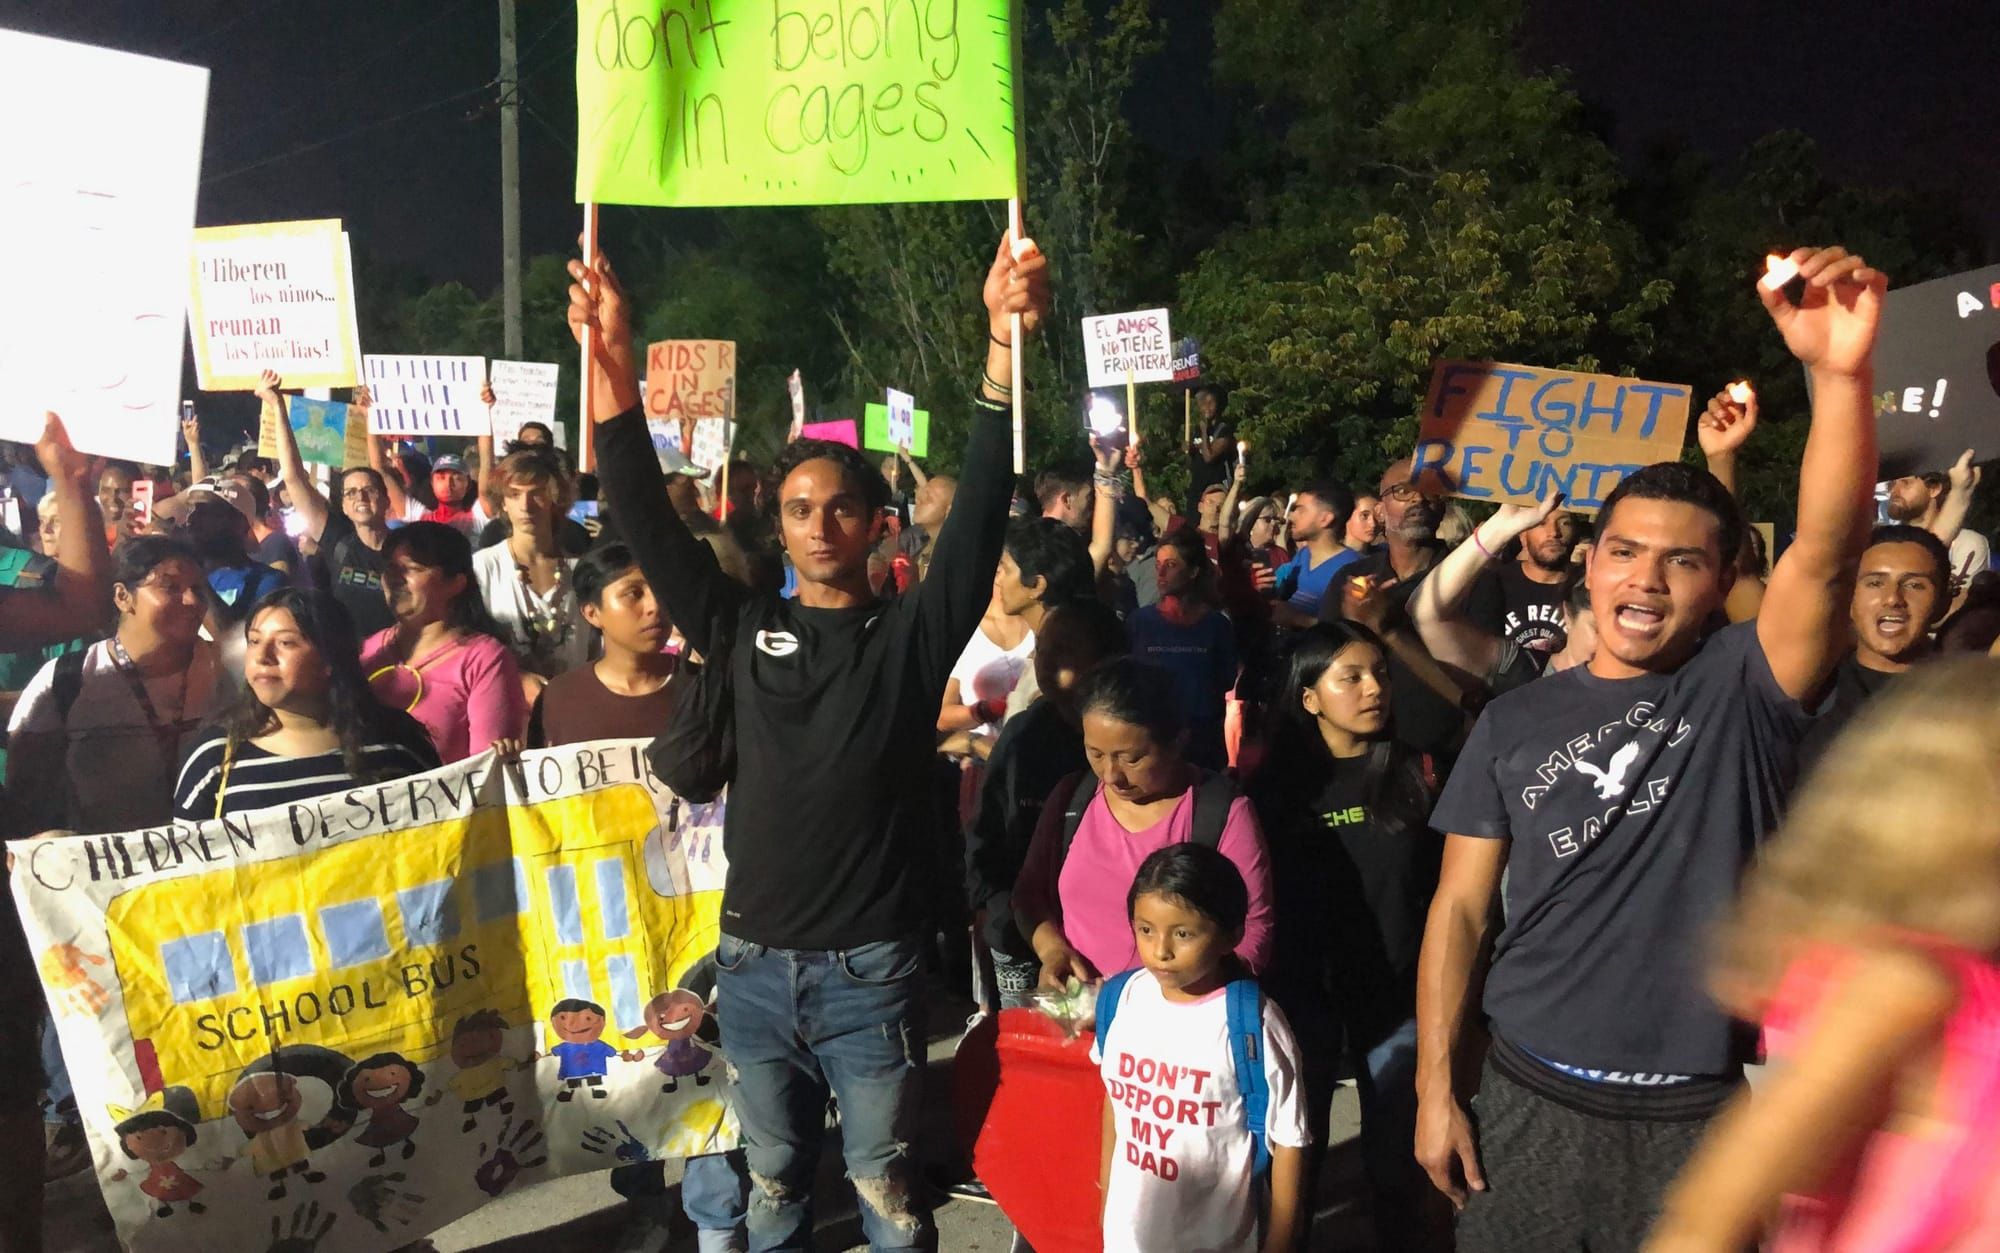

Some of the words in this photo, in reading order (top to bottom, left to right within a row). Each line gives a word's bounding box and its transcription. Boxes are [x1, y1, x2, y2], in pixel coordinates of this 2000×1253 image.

[771, 0, 960, 81] belong
[764, 81, 948, 176] cages
[250, 286, 273, 305] los
[209, 316, 281, 338] reunan
[1095, 320, 1111, 339] EL
[1123, 334, 1164, 354] TIENE
[651, 344, 706, 372] KIDS
[717, 342, 732, 370] R
[672, 373, 699, 392] IN
[649, 387, 732, 417] CAGES
[1434, 364, 1686, 440] FIGHT
[1496, 423, 1574, 458] TO
[1410, 437, 1642, 508] REUNIT
[288, 769, 486, 846] DESERVE
[503, 755, 563, 799] TO
[576, 747, 621, 790] BE
[197, 978, 387, 1051] SCHOOL
[401, 943, 481, 999] BUS
[1118, 1052, 1211, 1095] DON'T
[1108, 1077, 1222, 1127] DEPORT
[1130, 1116, 1175, 1151] MY
[1126, 1140, 1179, 1182] DAD
